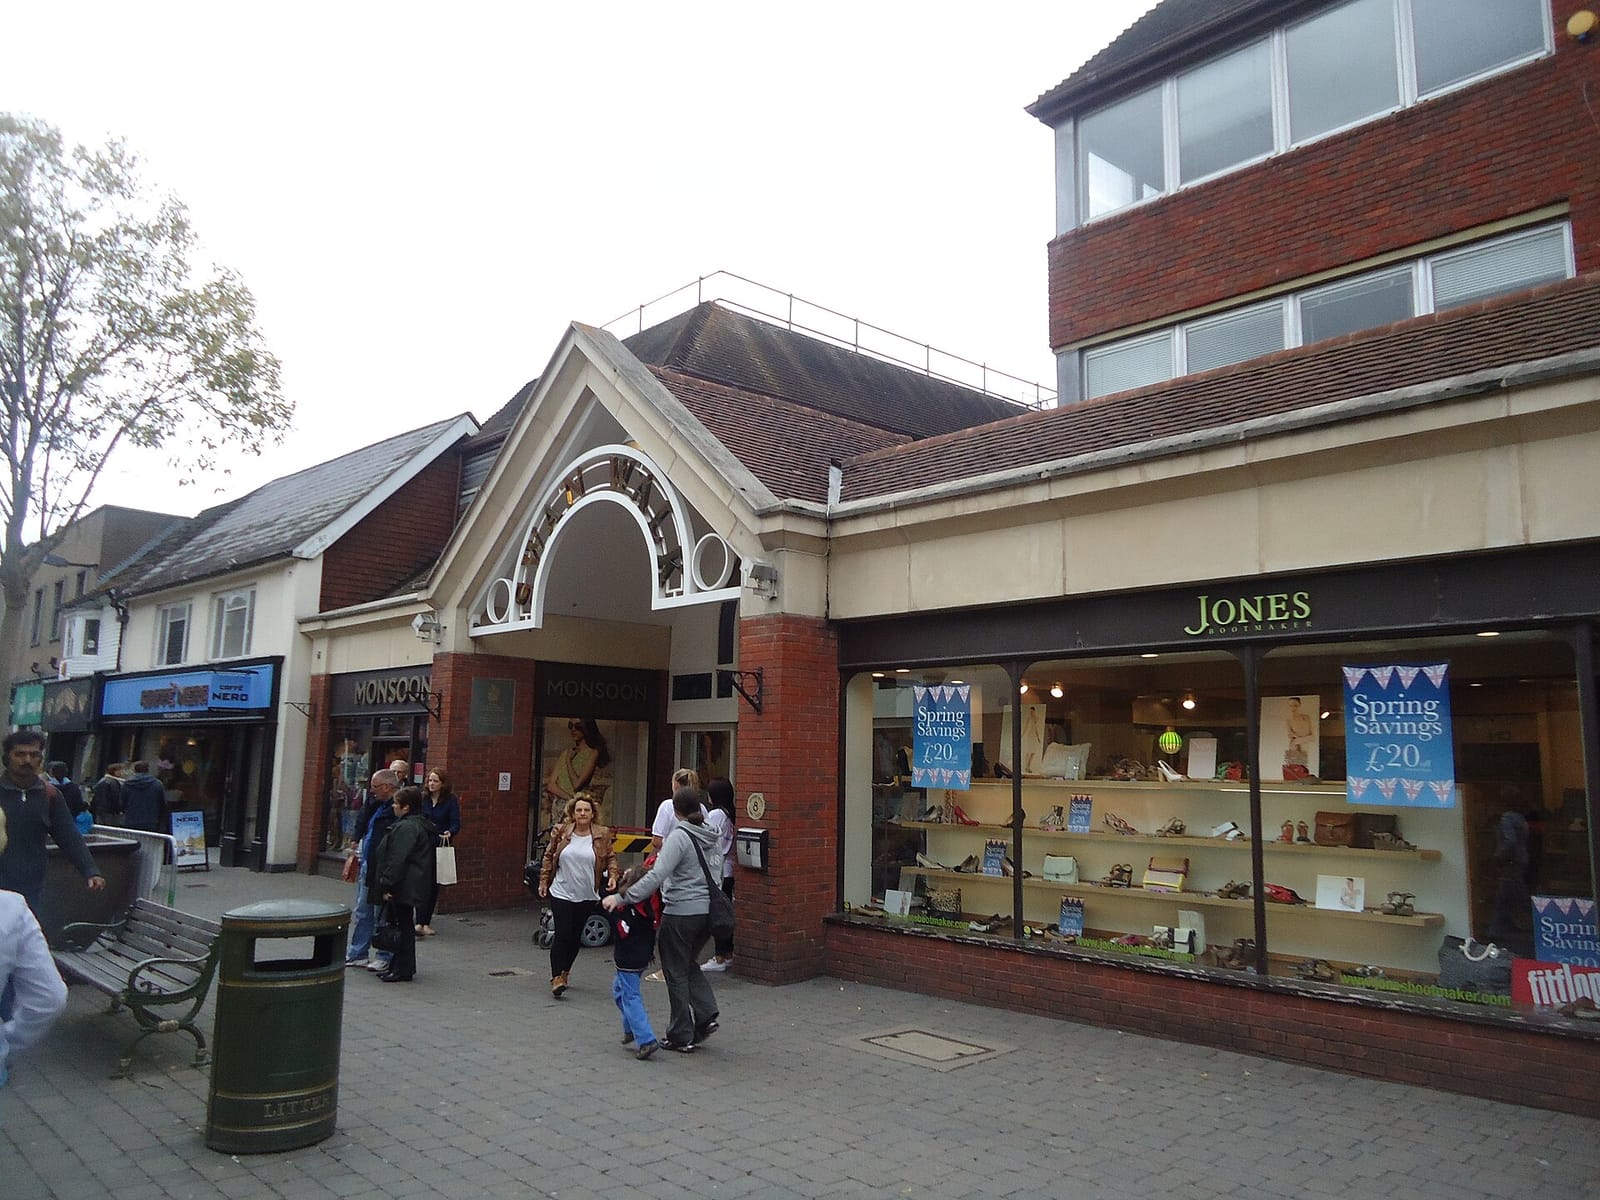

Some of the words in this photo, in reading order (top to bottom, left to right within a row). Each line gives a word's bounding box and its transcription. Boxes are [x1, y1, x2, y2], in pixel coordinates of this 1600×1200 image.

[1184, 591, 1311, 635] JONES
[1208, 620, 1312, 634] BOOTMAKER
[212, 692, 249, 701] NERO
[355, 675, 432, 705] MONSOON
[546, 679, 648, 701] MONSOON
[917, 705, 965, 727] Spring
[1352, 693, 1440, 722] Spring
[917, 721, 966, 742] Savings
[1354, 715, 1443, 742] Savings
[922, 742, 953, 764] £20
[1364, 743, 1420, 772] £20
[753, 801, 759, 811] 8
